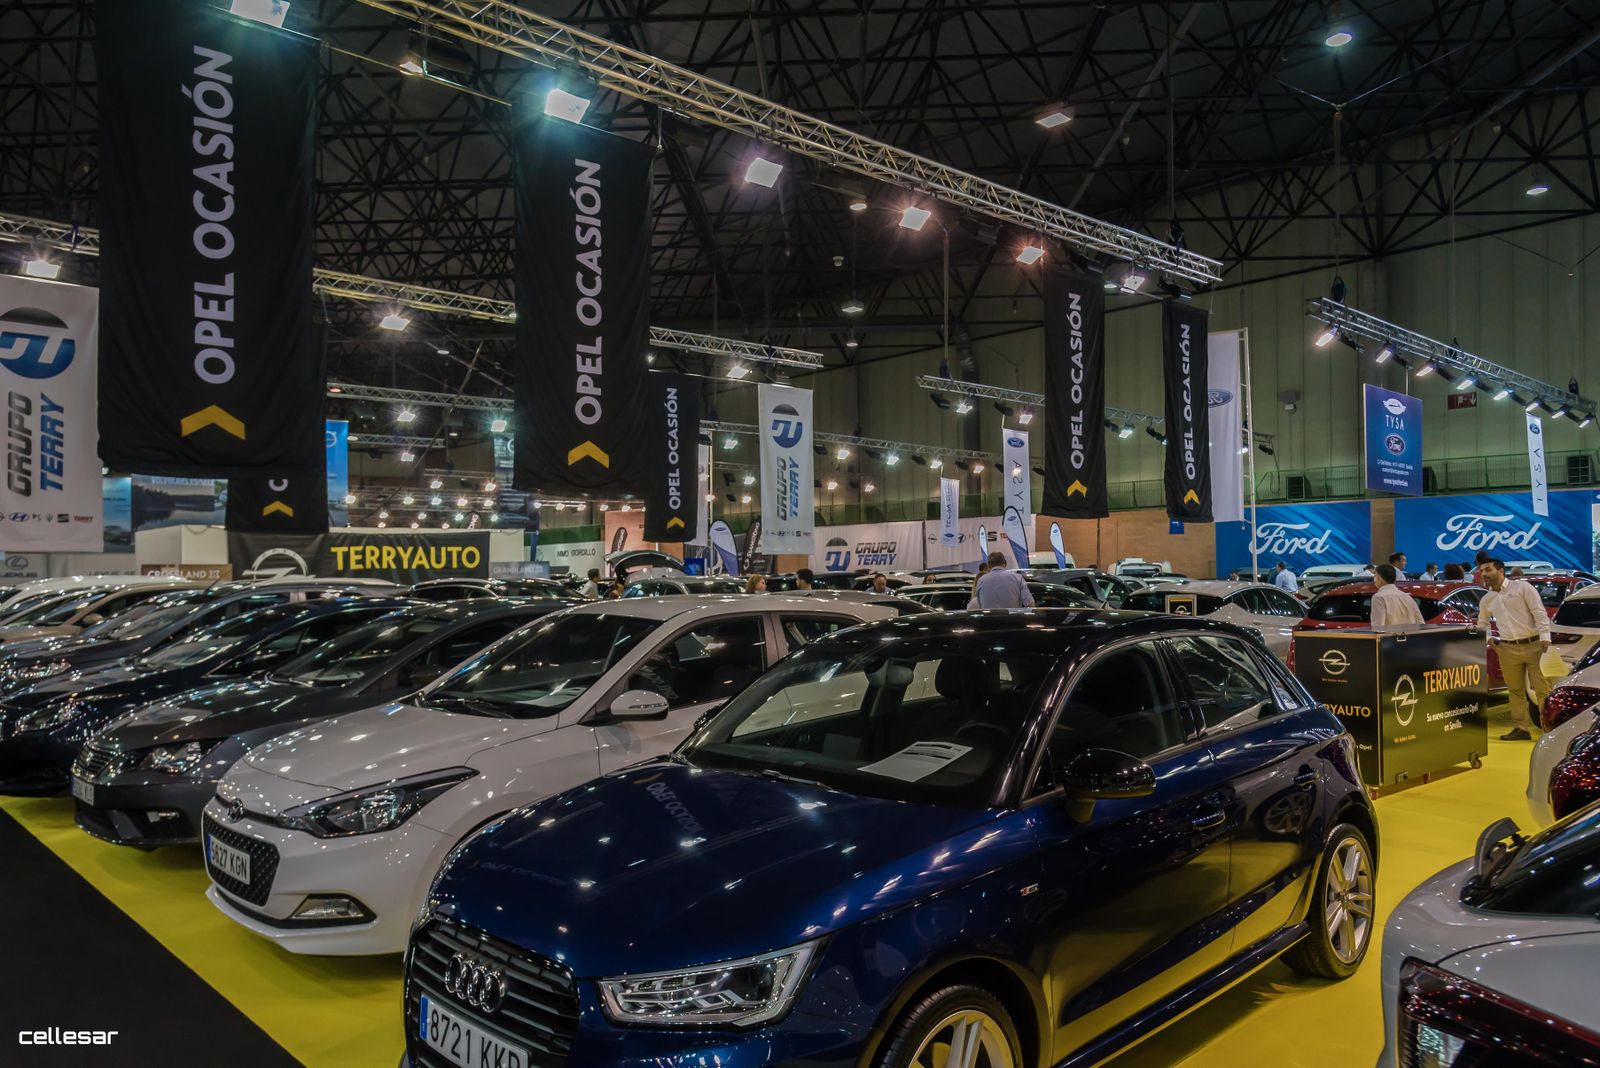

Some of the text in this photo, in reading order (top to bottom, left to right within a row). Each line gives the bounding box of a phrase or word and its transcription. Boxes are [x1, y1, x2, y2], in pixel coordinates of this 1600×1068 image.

[181, 45, 236, 385] OPEL OCASIÓN
[570, 158, 603, 425] OPEL OCASIÓN
[1066, 293, 1084, 470] OPEL OCASIÓN
[1179, 323, 1196, 480] OPEL OCASIÓN
[8, 390, 32, 497] GRUPO
[40, 391, 64, 491] TERRY
[664, 387, 681, 510] OPEL OCASIÓN
[1386, 414, 1405, 431] TYSA
[776, 456, 788, 521] GRUPO
[789, 456, 800, 517] TERRY
[1533, 447, 1543, 501] TYSA
[330, 545, 481, 571] TERRYAUTO
[855, 542, 897, 554] GRUPO
[1248, 522, 1332, 554] Ford
[1436, 514, 1542, 550] Ford
[857, 554, 897, 566] TERRY
[1423, 664, 1481, 694] TERRYAUTO
[1323, 703, 1371, 718] RYAUTO
[229, 852, 248, 880] KGN
[430, 1008, 471, 1065] 8721
